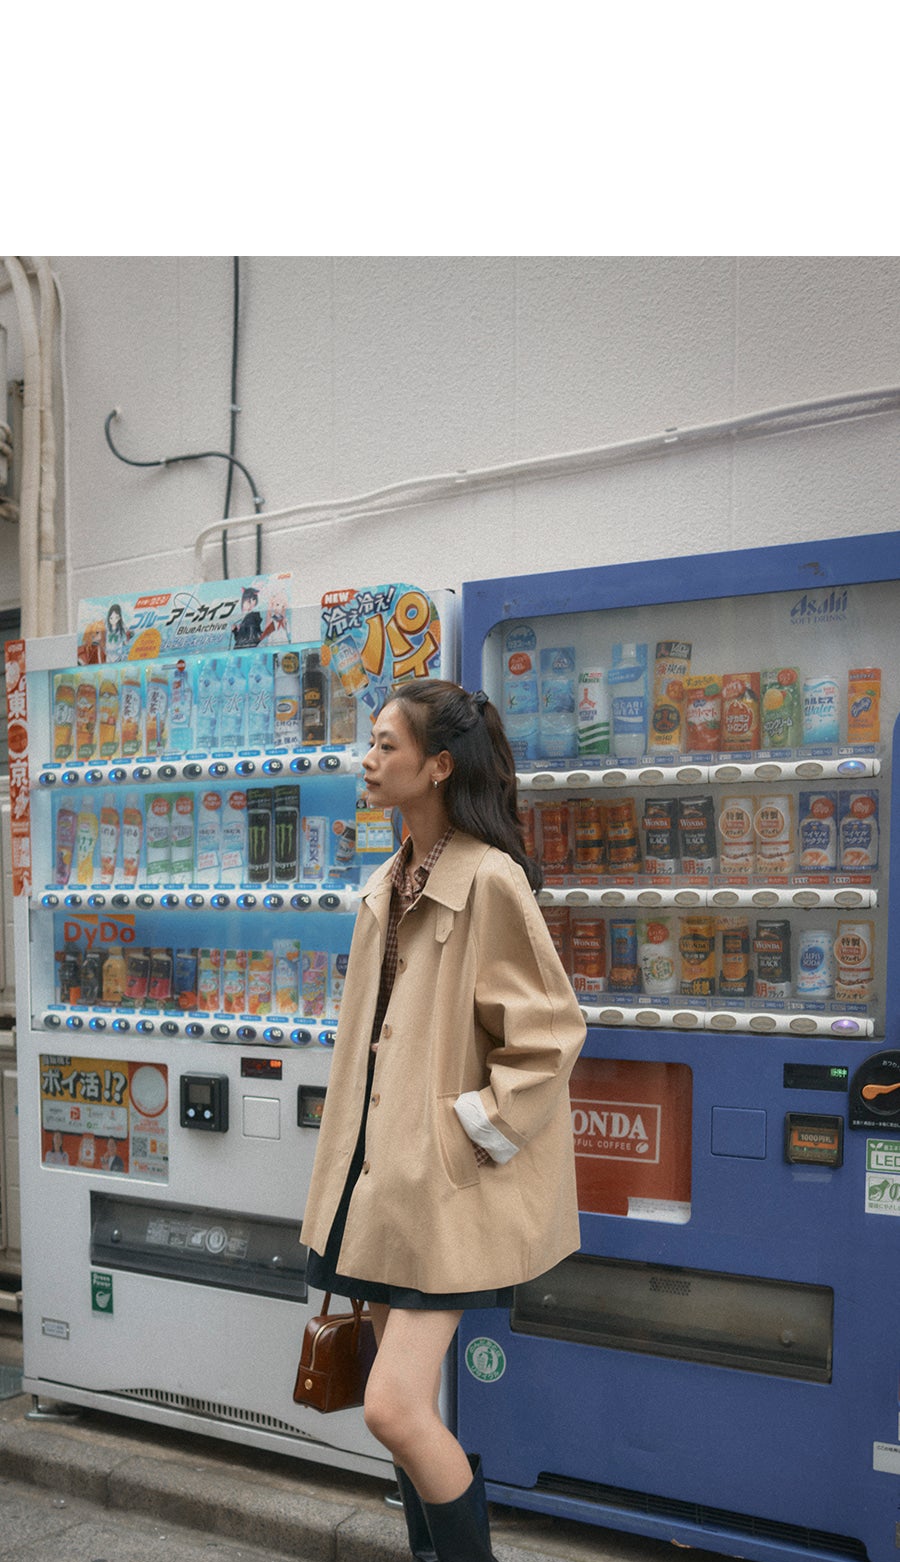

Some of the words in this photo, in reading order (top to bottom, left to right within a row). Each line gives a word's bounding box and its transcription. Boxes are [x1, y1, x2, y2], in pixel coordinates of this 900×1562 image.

[325, 591, 350, 604] NEW
[790, 590, 848, 616] Asahi
[129, 600, 240, 630] ブルーアーカイブ
[361, 591, 439, 690] パイ
[310, 828, 319, 863] FRISK
[64, 922, 135, 949] DyDo
[573, 938, 599, 946] WONDA
[841, 937, 860, 946] 特製
[756, 941, 780, 949] WONDA
[573, 977, 586, 991] 朝
[571, 1109, 648, 1140] ONDA
[800, 1133, 833, 1143] 1000円札
[597, 1140, 631, 1151] COFFEE
